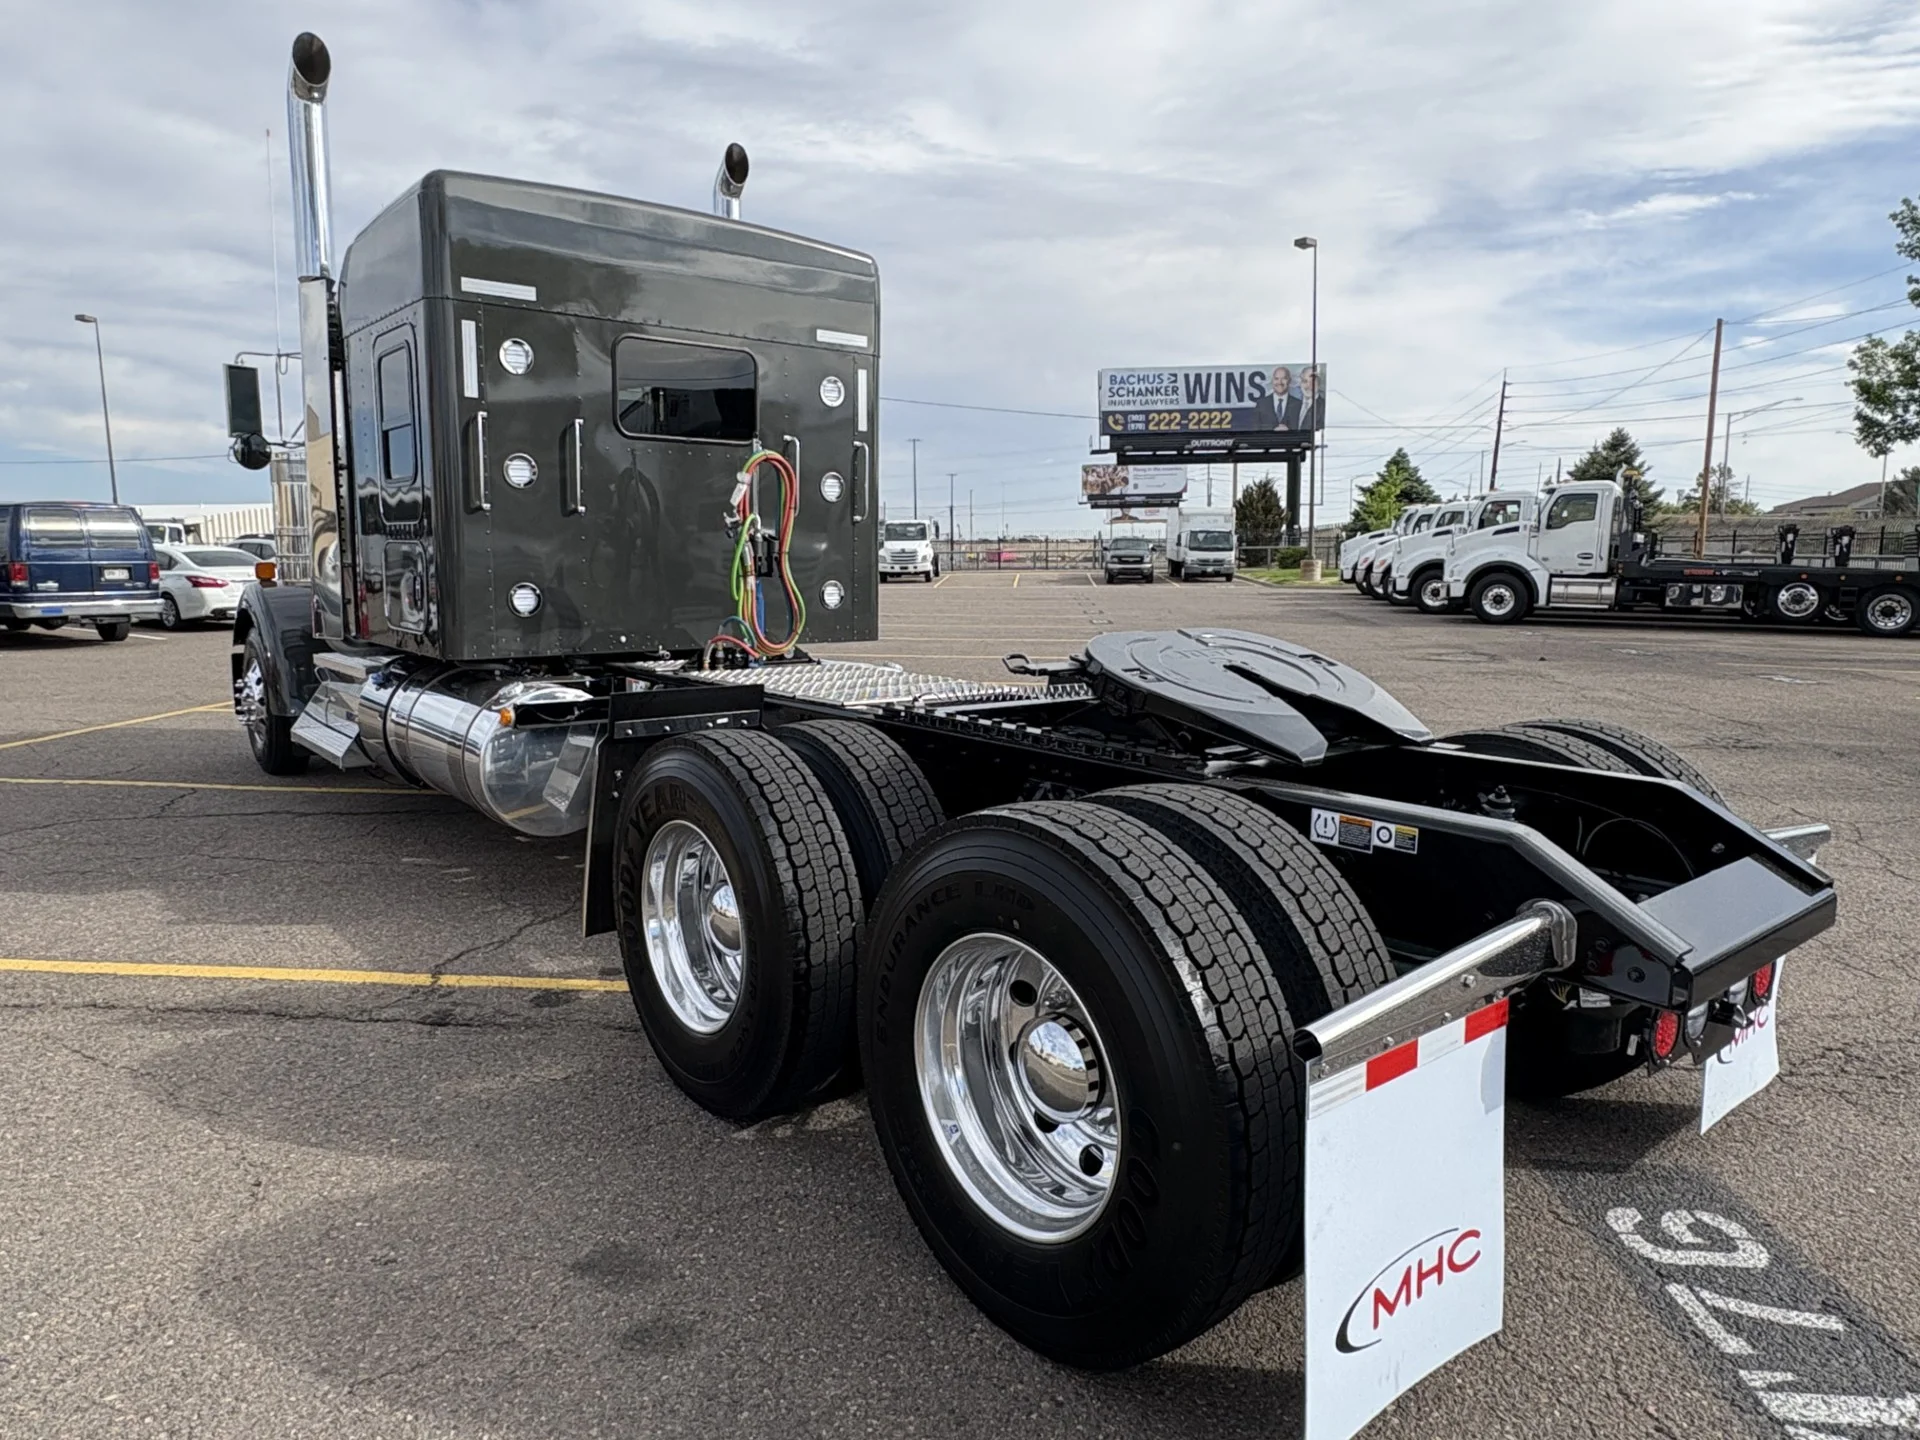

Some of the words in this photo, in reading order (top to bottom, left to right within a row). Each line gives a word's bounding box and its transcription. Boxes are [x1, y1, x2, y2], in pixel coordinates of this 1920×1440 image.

[1109, 373, 1164, 386] BACHUS
[1184, 371, 1266, 404] WINS
[1108, 385, 1179, 398] SCHANKER
[1108, 399, 1137, 407] INJURY
[1139, 397, 1180, 406] LAWYERS
[1148, 411, 1232, 430] 222-2222
[877, 881, 962, 1048] ENDURANCE
[1373, 1228, 1481, 1330] MHC
